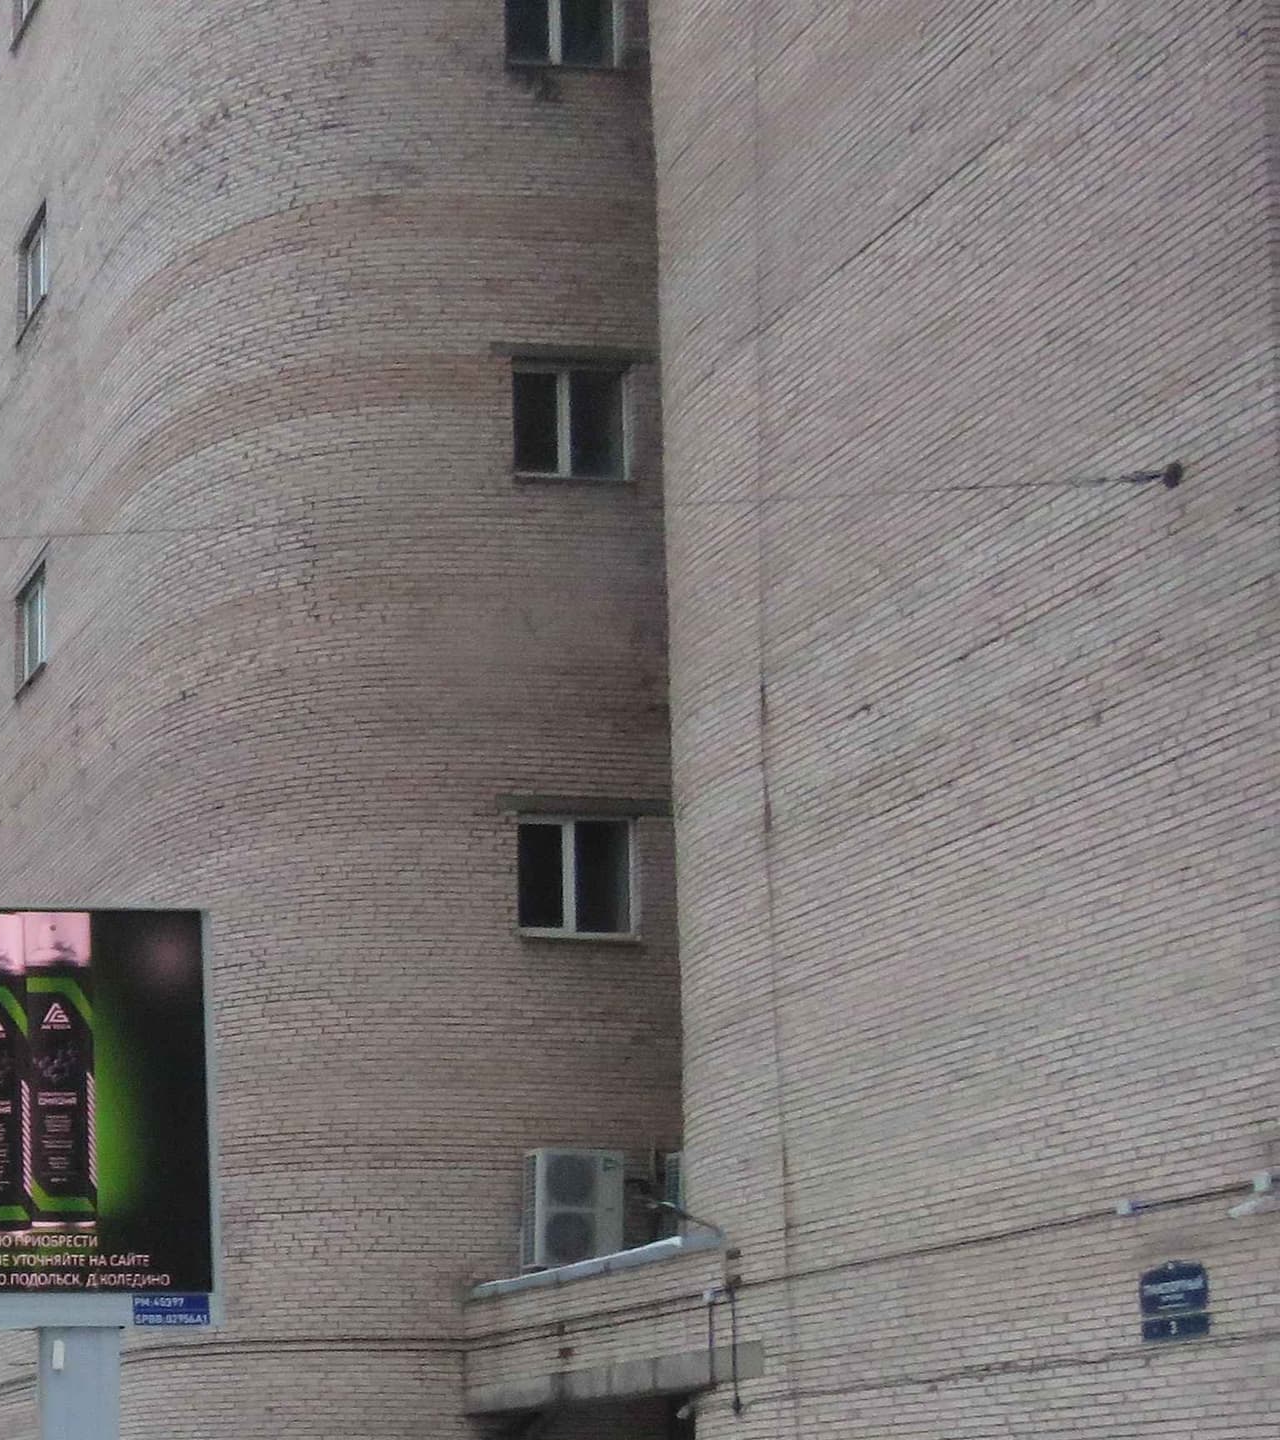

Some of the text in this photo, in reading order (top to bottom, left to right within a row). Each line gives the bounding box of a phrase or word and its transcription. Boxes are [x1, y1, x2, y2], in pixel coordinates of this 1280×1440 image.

[15, 1234, 98, 1248] ПРИОБРЕСТИ
[13, 1252, 85, 1266] УТОЧНЯЙТЕ
[89, 1255, 108, 1266] НА
[110, 1252, 150, 1266] САЙТЕ
